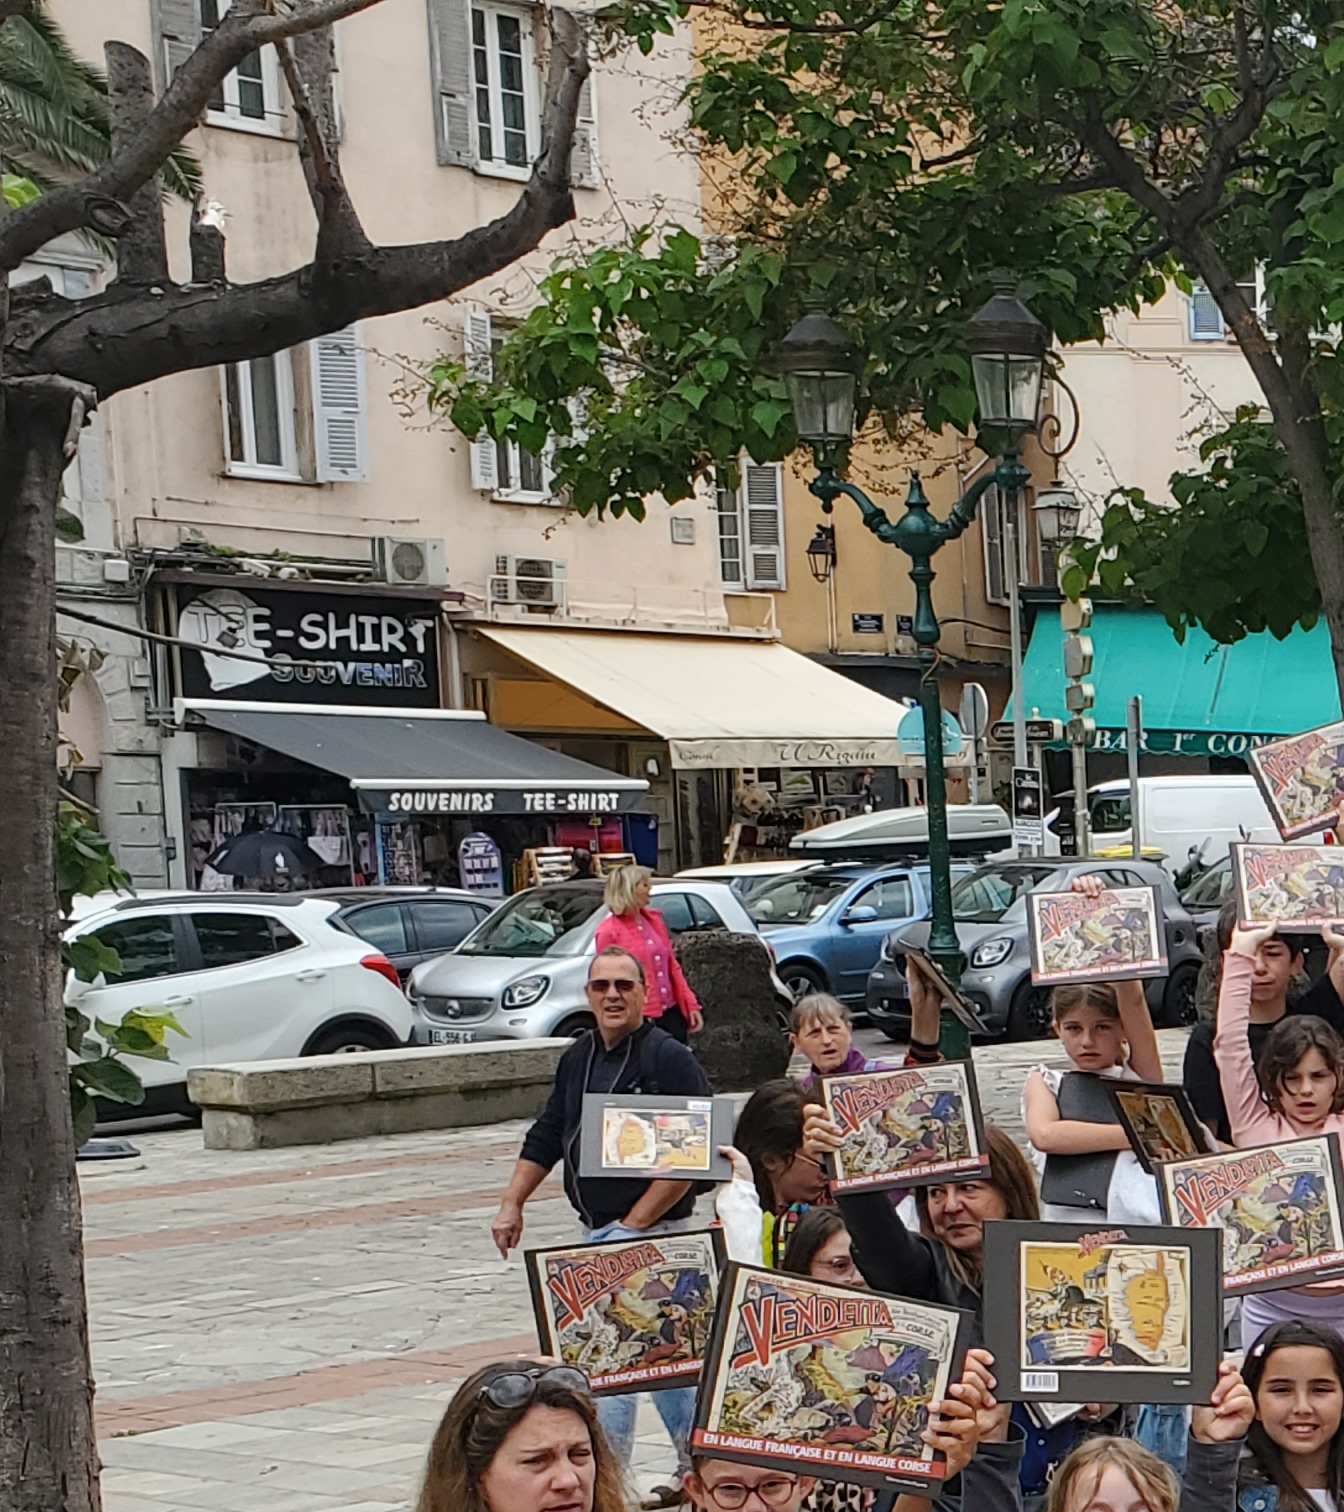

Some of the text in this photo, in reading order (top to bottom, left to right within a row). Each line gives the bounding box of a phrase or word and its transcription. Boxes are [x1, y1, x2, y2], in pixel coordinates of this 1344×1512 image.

[187, 603, 433, 653] TEE-SHIRT
[271, 653, 427, 688] SOUVENIR
[1093, 731, 1148, 750] BAR
[388, 793, 619, 812] SOUVENIRS TEE-SHIRT
[549, 1243, 667, 1323] VENDETTA
[741, 1295, 895, 1367] VENDETTA
[905, 1322, 935, 1339] CORSE
[703, 1433, 931, 1473] EN LANGUE FRANÇAISE ET EN LANGUE CORSE
